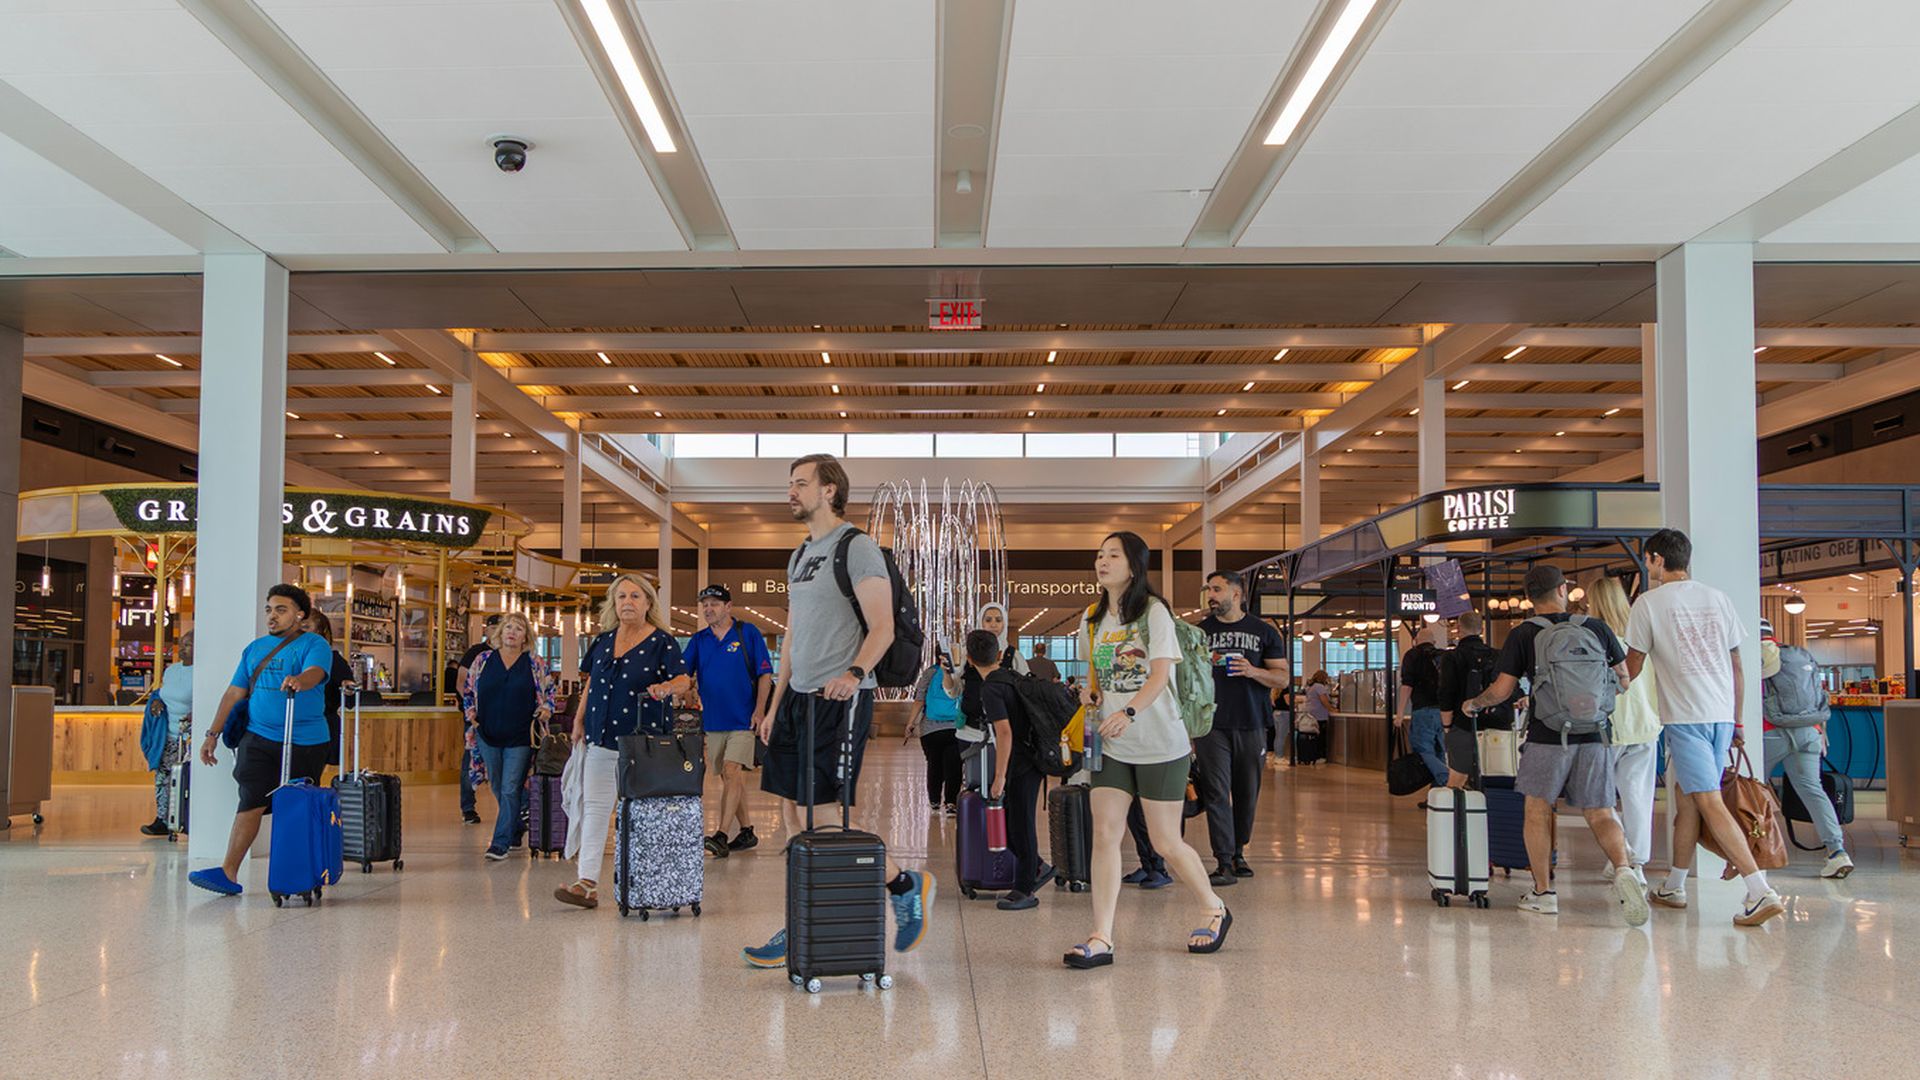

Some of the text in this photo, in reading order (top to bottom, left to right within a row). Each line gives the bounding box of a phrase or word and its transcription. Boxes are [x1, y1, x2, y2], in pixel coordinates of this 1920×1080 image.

[939, 301, 974, 325] EXIT
[1443, 489, 1516, 520] PARISI
[344, 506, 470, 535] GRAINS
[1447, 516, 1509, 533] COFFEE
[1760, 545, 1822, 569] LTVATING
[119, 608, 170, 627] IFTS
[1401, 602, 1436, 611] PRONTO
[1206, 631, 1261, 652] LESTINE
